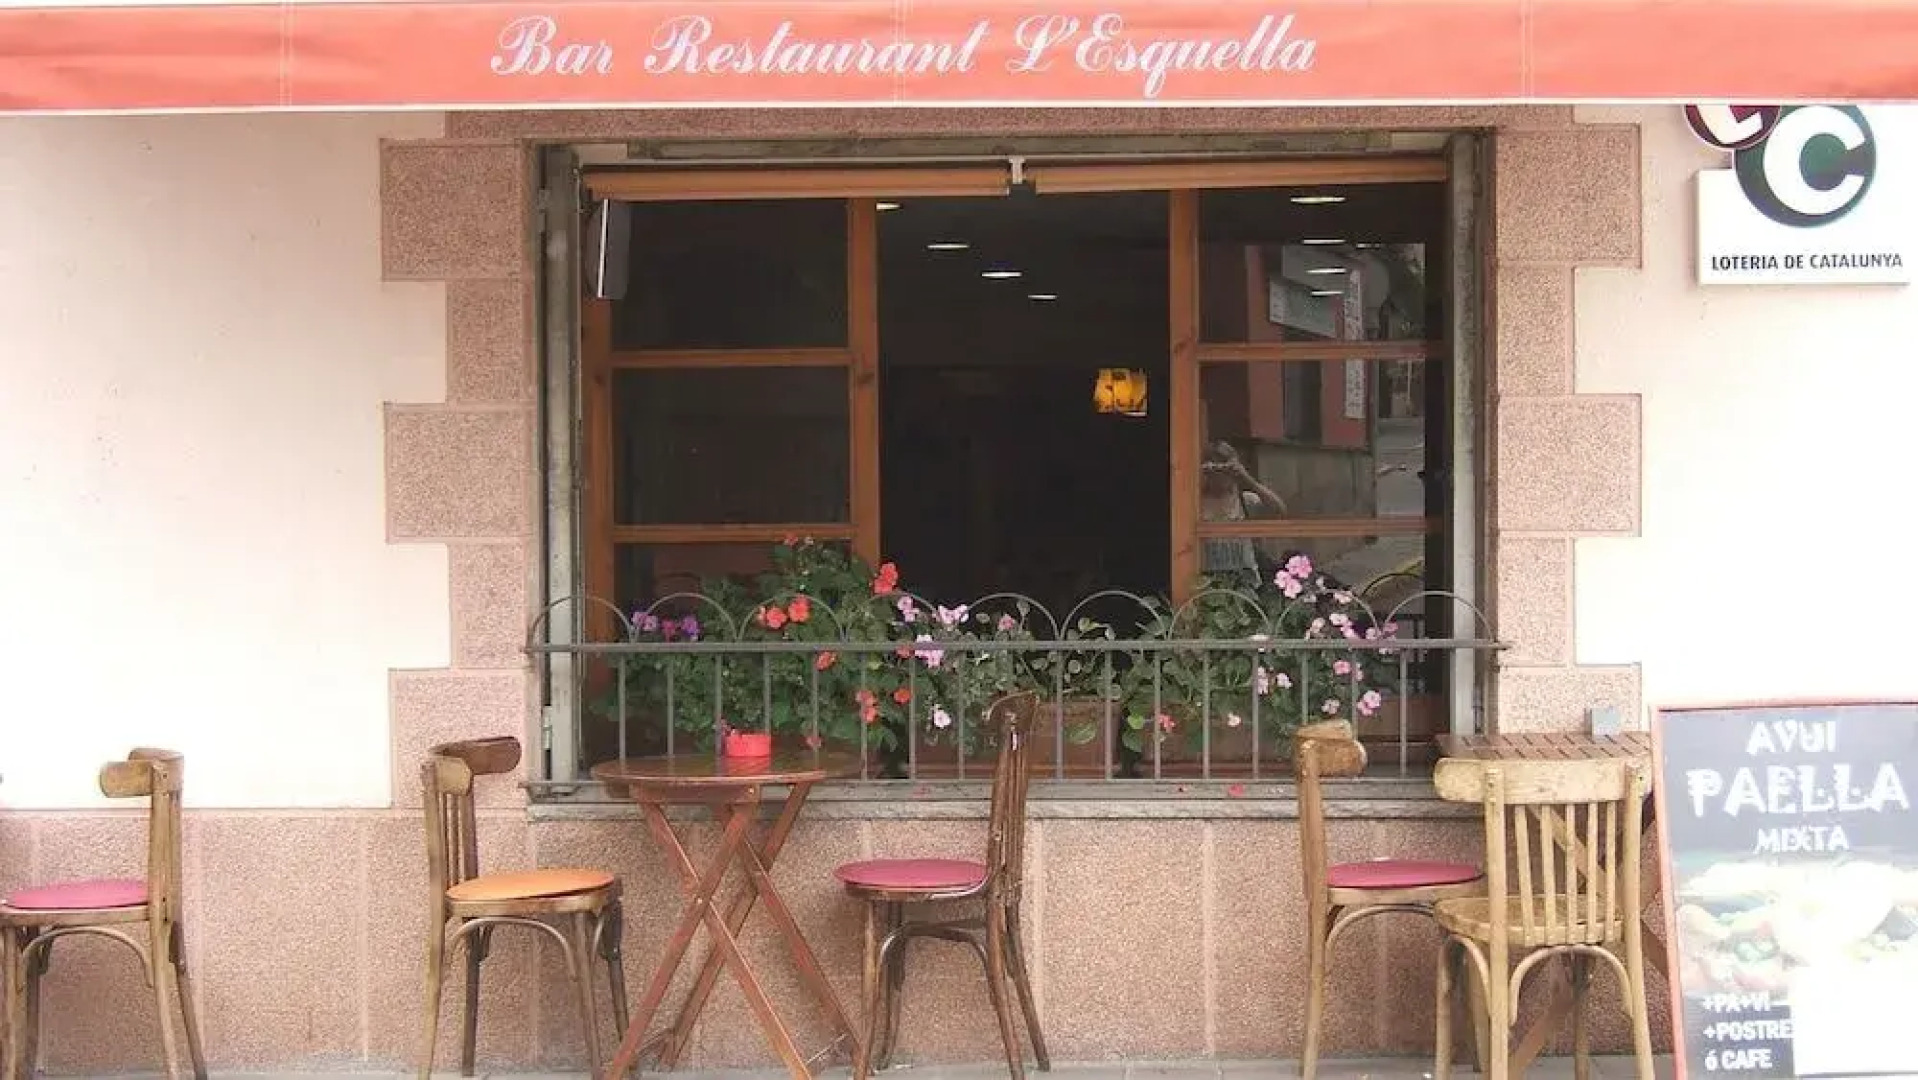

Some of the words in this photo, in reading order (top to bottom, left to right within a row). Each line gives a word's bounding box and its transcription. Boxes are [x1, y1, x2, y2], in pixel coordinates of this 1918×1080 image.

[490, 15, 613, 75] Bar
[644, 15, 990, 75] Restaurant
[1005, 13, 1317, 99] L'Esquella
[1712, 254, 1778, 271] LOTERIA
[1784, 254, 1804, 270] DE
[1810, 252, 1903, 269] CATALUNYA
[1746, 719, 1837, 756] AVUI
[1686, 763, 1910, 817] PAELLA
[1754, 825, 1850, 853] MIXTA
[1721, 1049, 1773, 1070] CAFE
